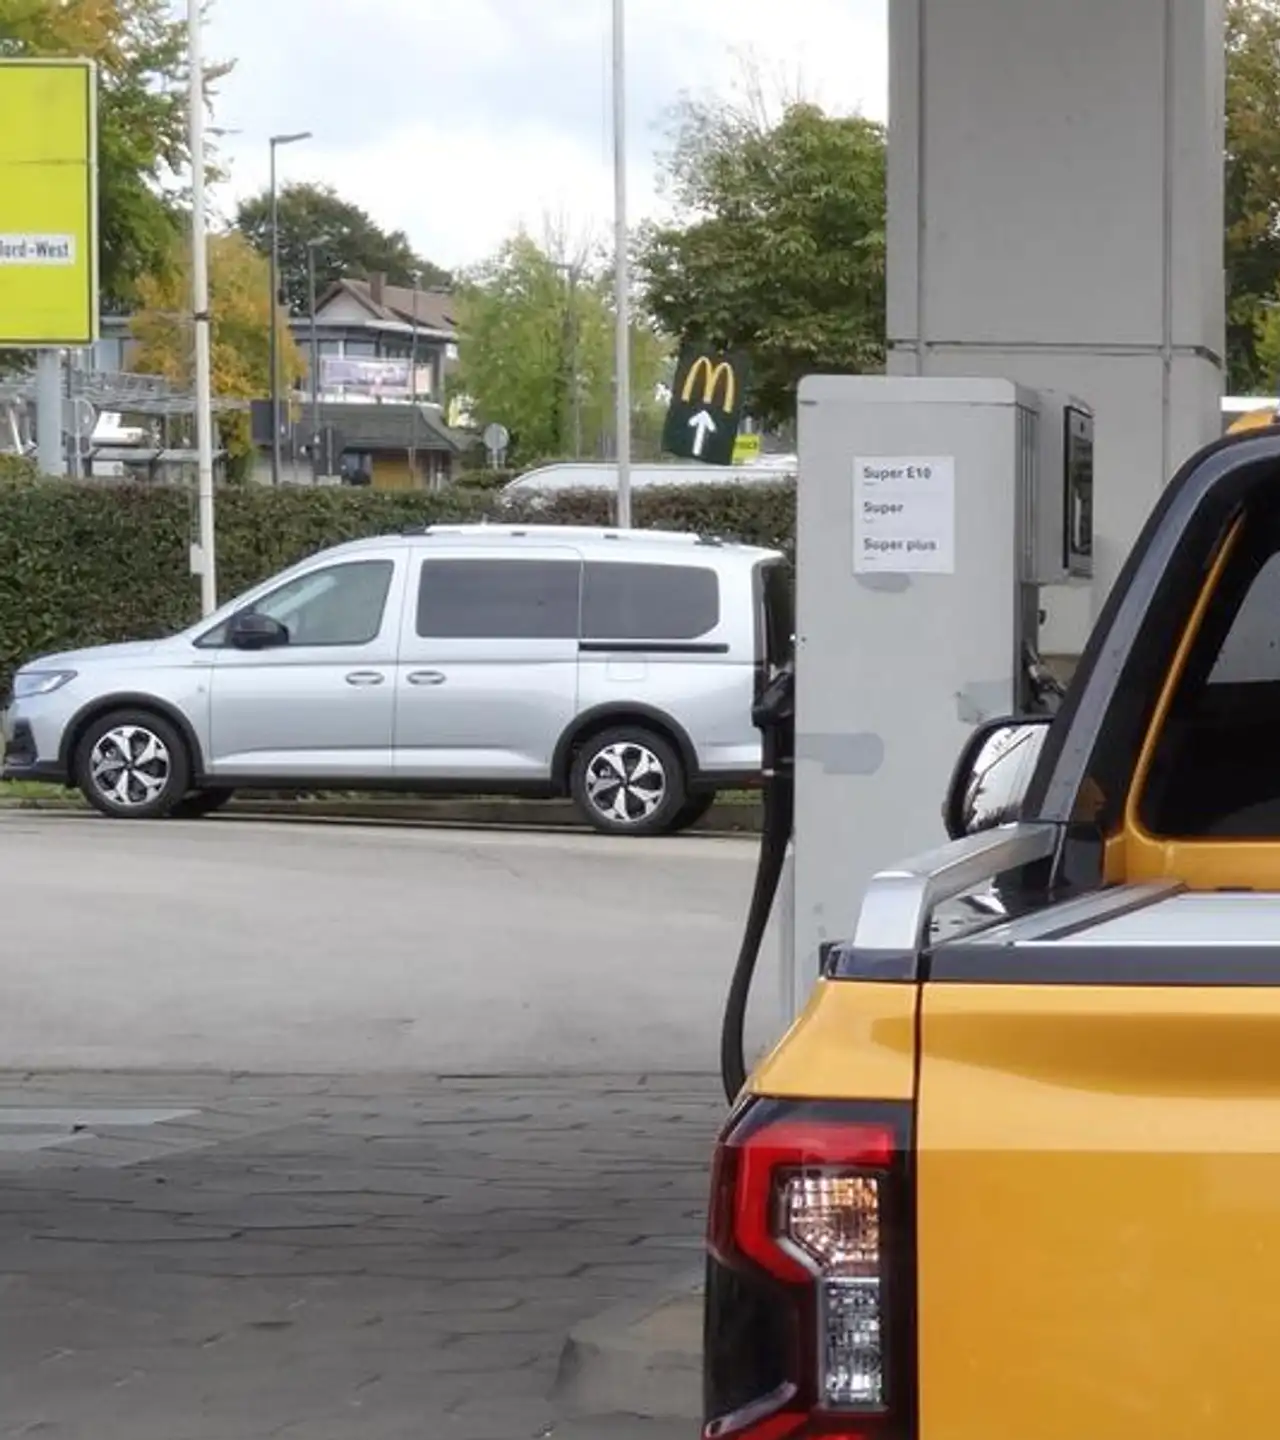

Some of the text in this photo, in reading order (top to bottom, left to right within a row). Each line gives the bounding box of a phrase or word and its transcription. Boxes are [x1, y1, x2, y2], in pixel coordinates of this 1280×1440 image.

[0, 239, 68, 258] ord-West
[864, 466, 932, 481] Super E10
[864, 501, 904, 515] Super
[864, 538, 937, 553] Super plus
